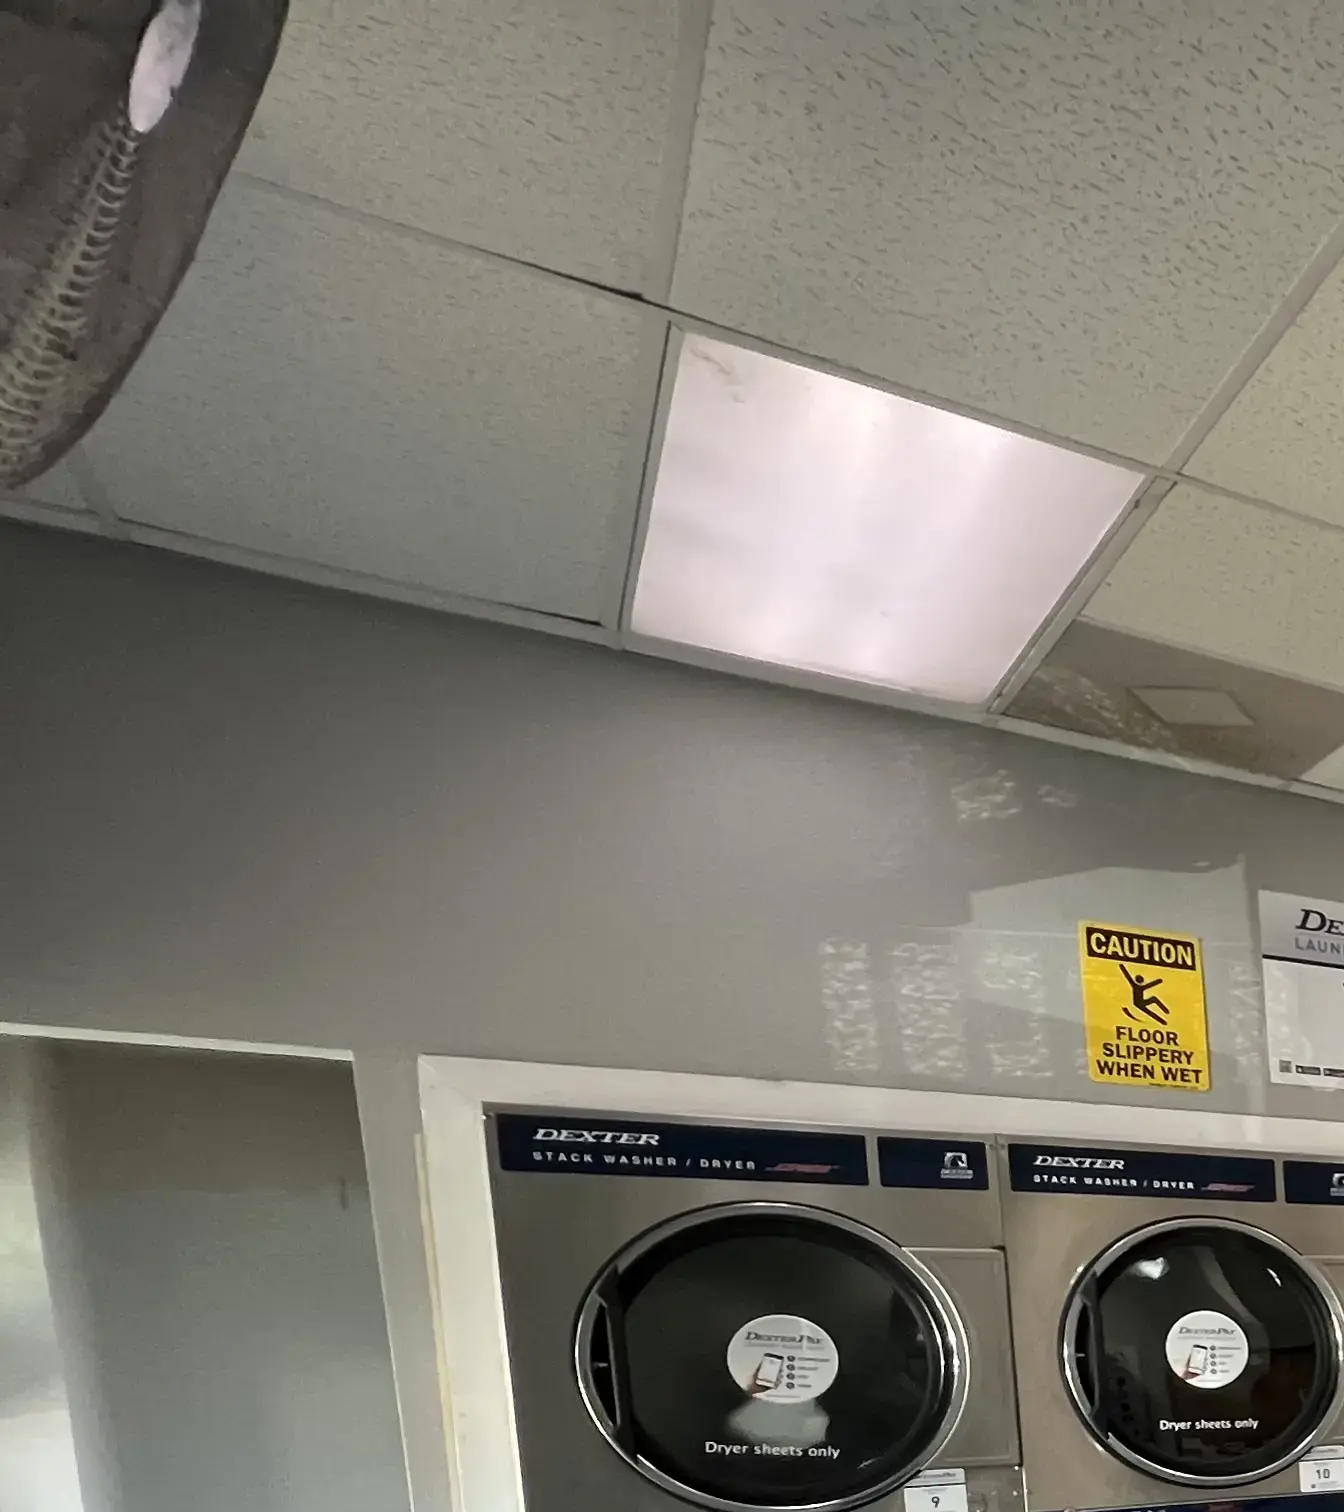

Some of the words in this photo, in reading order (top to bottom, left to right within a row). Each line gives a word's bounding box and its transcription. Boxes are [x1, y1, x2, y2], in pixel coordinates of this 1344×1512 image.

[1090, 932, 1193, 967] CAUTION
[1115, 1024, 1179, 1047] FLOOR
[1102, 1041, 1195, 1065] SLIPPERY
[1096, 1059, 1156, 1081] WHEN
[1161, 1063, 1203, 1085] WET
[532, 1127, 661, 1146] DEXTER
[532, 1151, 594, 1164] STACK
[603, 1153, 677, 1167] WASHER
[700, 1158, 756, 1171] DRYER
[1033, 1155, 1126, 1170] DEXTER
[1033, 1174, 1077, 1185] STACK
[1083, 1177, 1138, 1189] WASHER
[1152, 1179, 1195, 1191] DRYER
[1159, 1419, 1192, 1432] Dryer
[1194, 1418, 1232, 1430] sheets
[1234, 1417, 1259, 1430] only
[704, 1441, 749, 1456] Dryer
[753, 1443, 804, 1457] sheets
[808, 1445, 841, 1460] only
[1315, 1468, 1330, 1480] 10
[931, 1496, 940, 1508] 9
